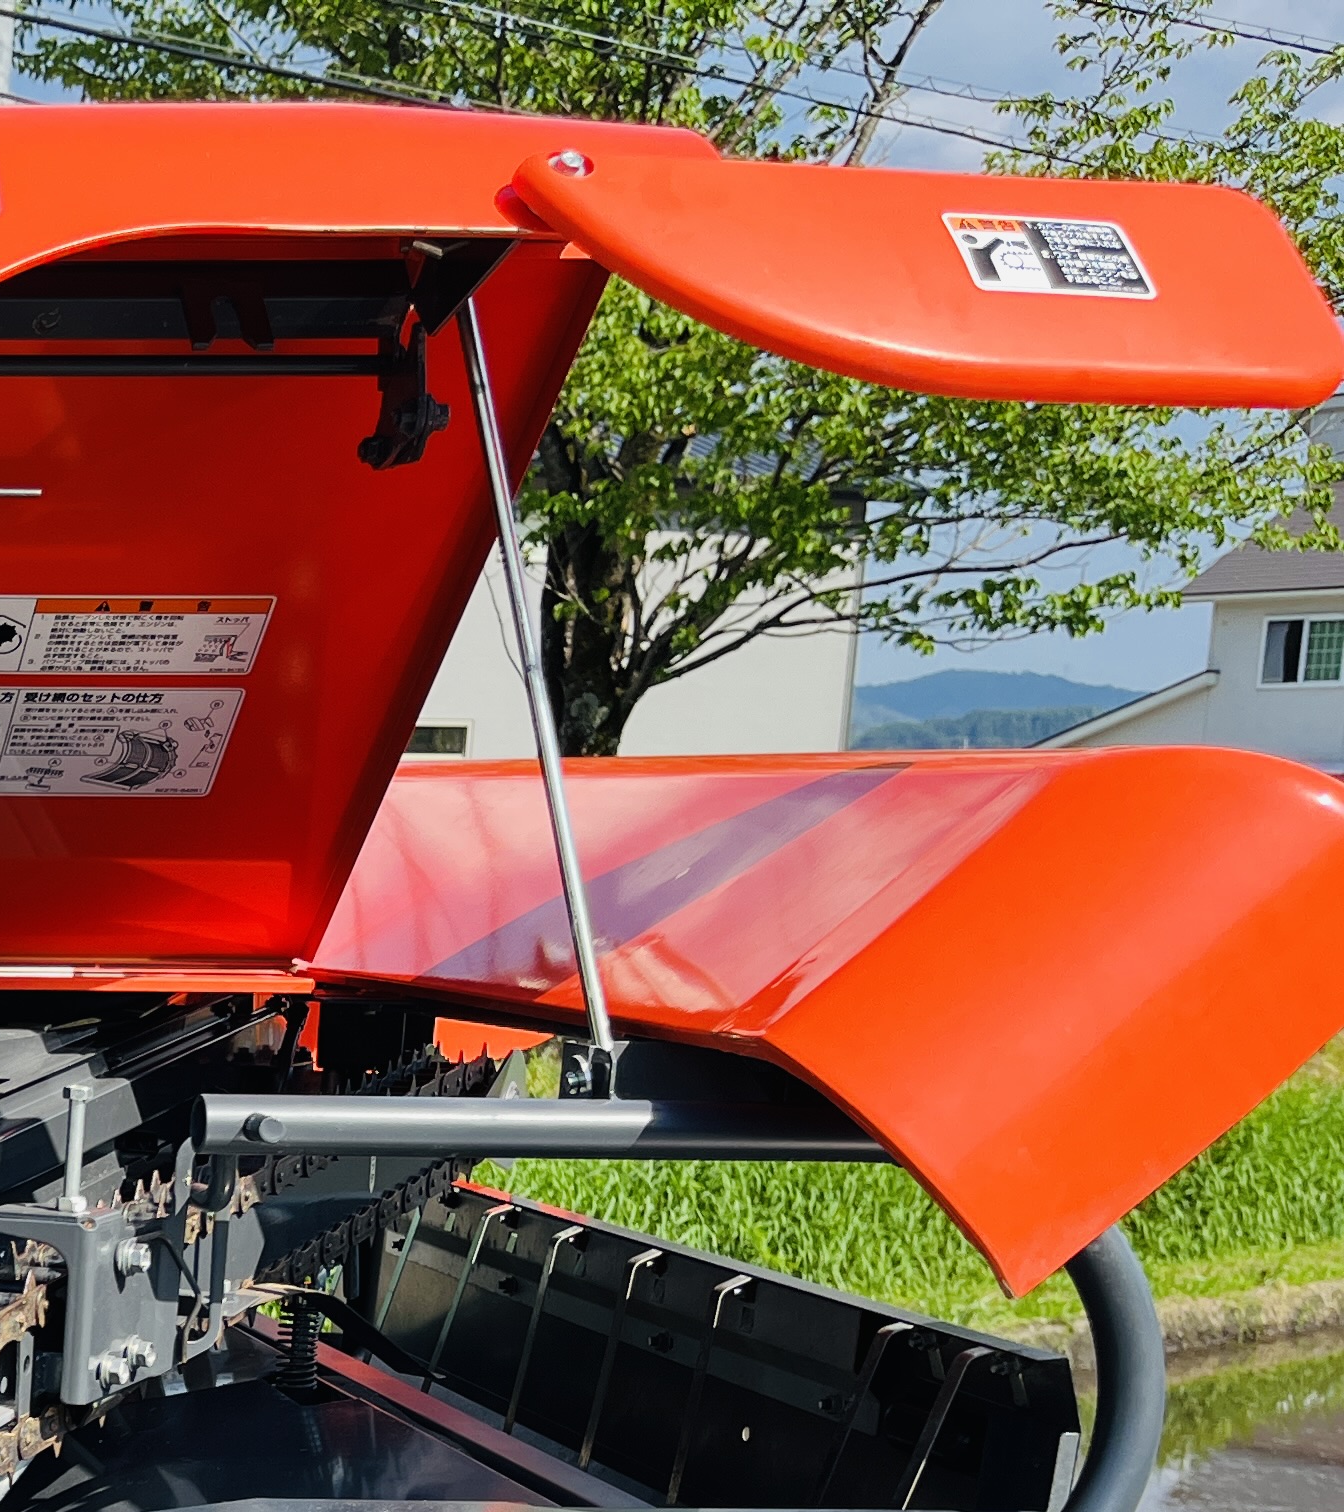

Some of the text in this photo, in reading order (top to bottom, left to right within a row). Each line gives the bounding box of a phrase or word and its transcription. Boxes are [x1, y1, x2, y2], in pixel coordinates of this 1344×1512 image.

[215, 616, 251, 624] ストッパ
[24, 692, 165, 704] 受け網のセットの仕方
